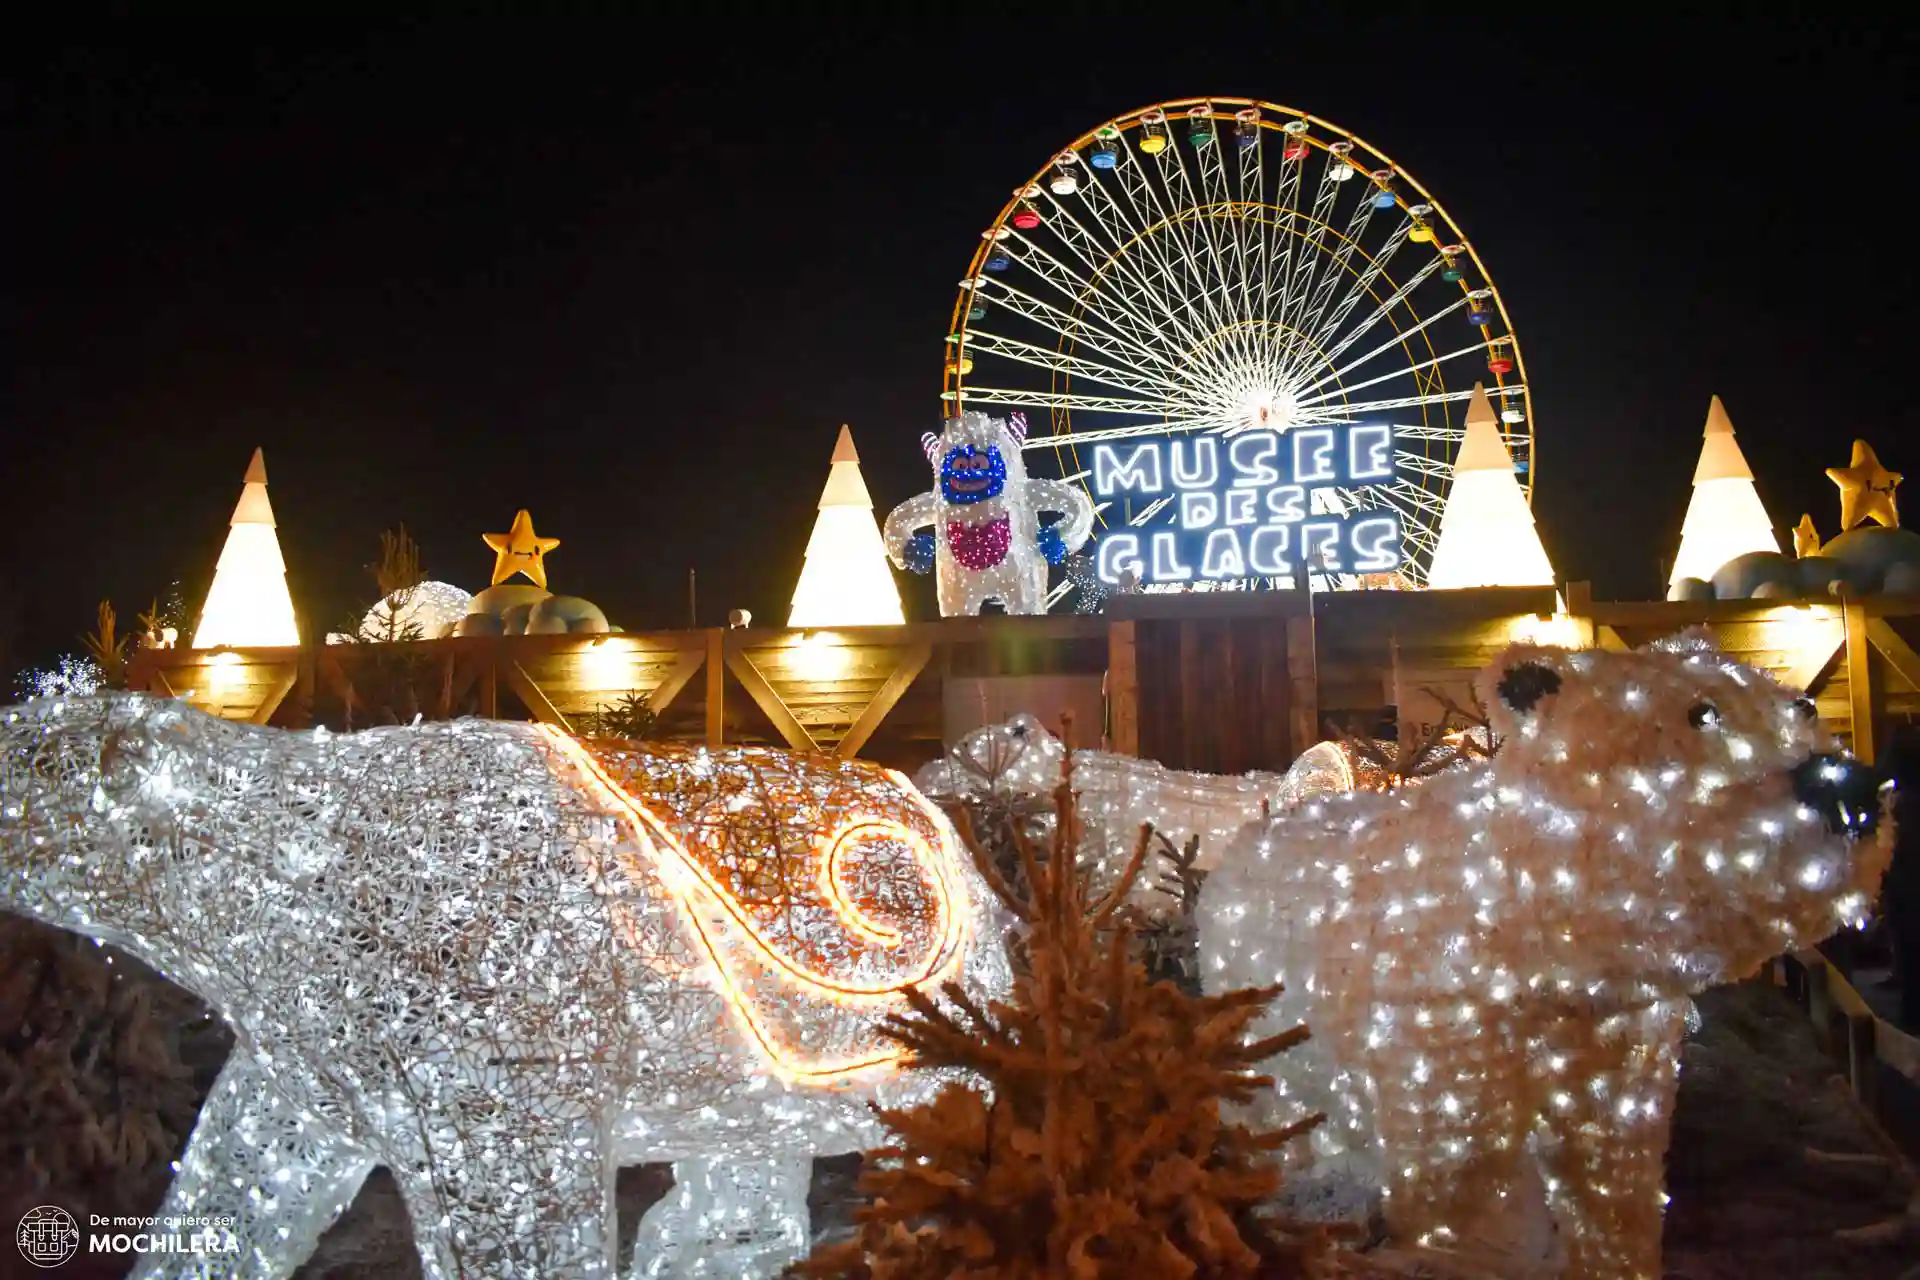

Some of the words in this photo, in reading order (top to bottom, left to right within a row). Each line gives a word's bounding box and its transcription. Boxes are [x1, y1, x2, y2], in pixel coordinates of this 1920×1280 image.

[1093, 424, 1393, 495] MUSEE
[1181, 485, 1306, 529] DES
[1098, 518, 1401, 584] GLACES
